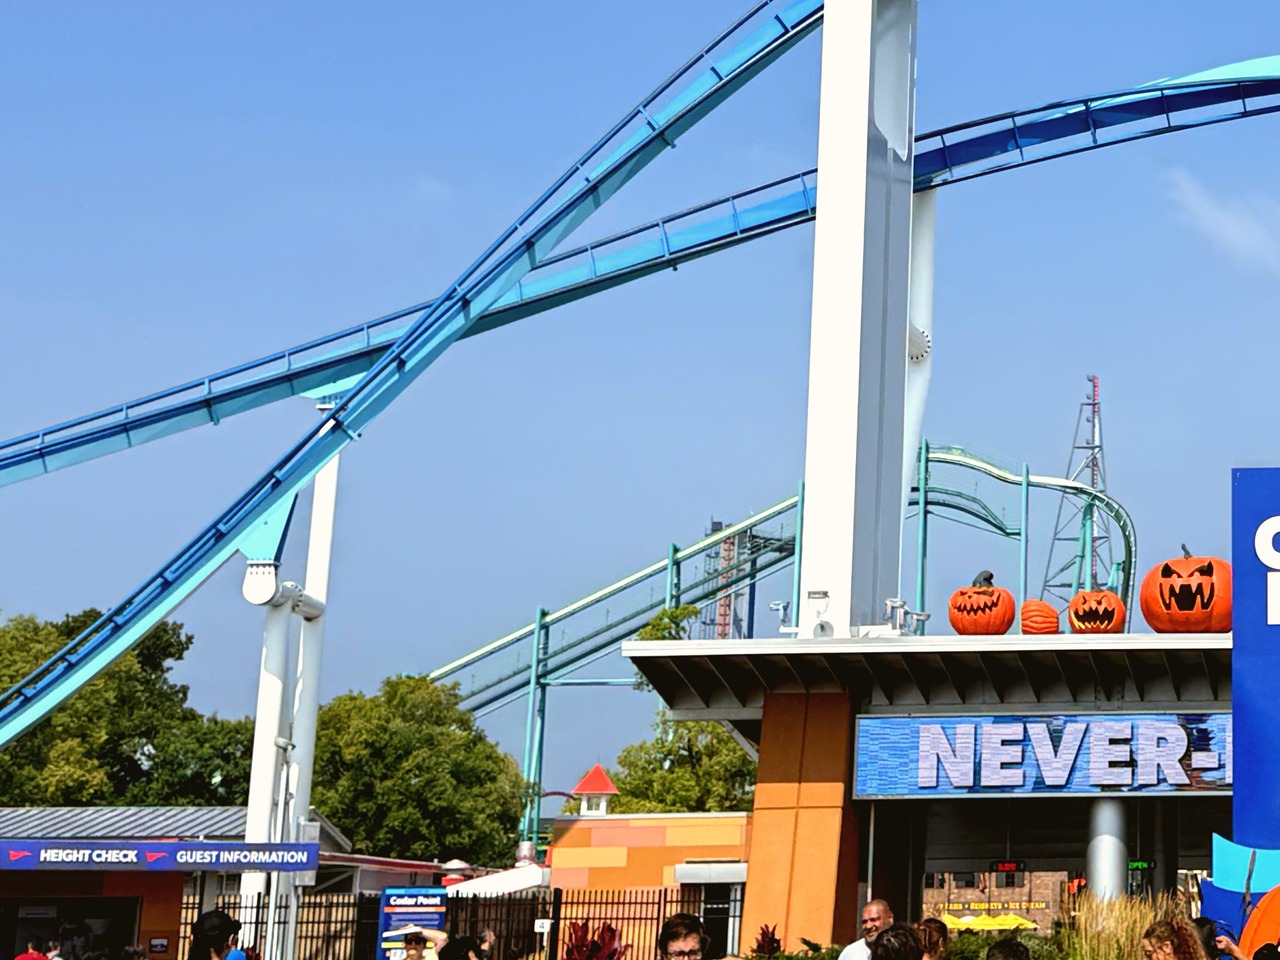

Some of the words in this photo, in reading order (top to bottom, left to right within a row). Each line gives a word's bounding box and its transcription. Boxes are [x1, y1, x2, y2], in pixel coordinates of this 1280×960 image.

[918, 722, 1233, 787] NEVER-
[39, 849, 91, 863] HEIGHT
[92, 849, 138, 863] CHECK
[176, 850, 218, 863] GUEST
[219, 850, 308, 864] INFORMATION
[389, 896, 416, 906] Cedar
[417, 896, 441, 906] Point
